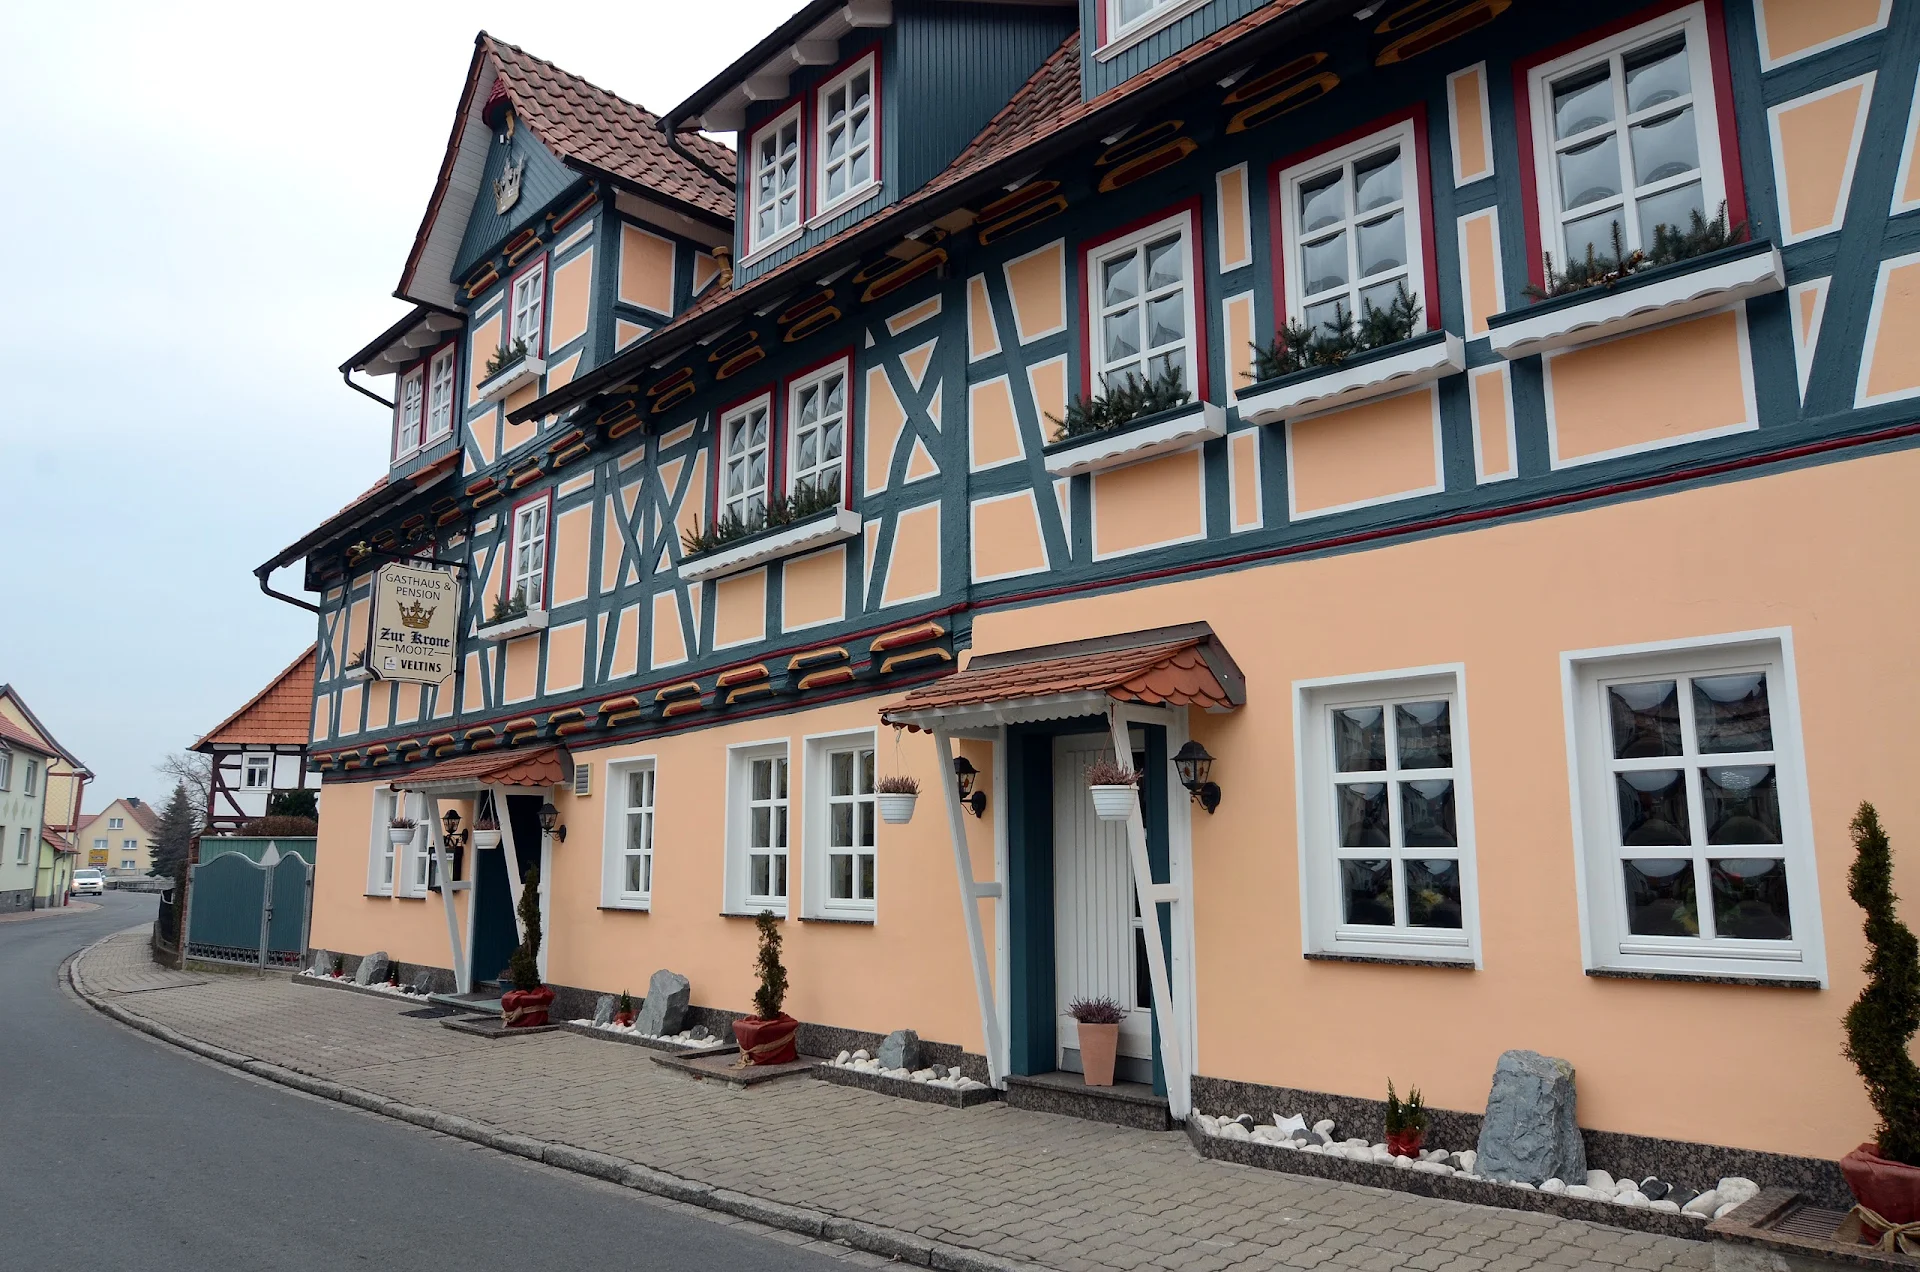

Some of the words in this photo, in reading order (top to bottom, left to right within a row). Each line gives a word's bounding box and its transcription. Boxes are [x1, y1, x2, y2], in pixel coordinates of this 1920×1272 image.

[385, 573, 441, 589] GASTHAUS
[443, 582, 451, 591] &
[396, 586, 441, 600] PENSION
[380, 627, 405, 643] Zur
[410, 631, 450, 648] Krone
[395, 644, 434, 657] MOOTZ
[400, 659, 442, 672] VELTINS
